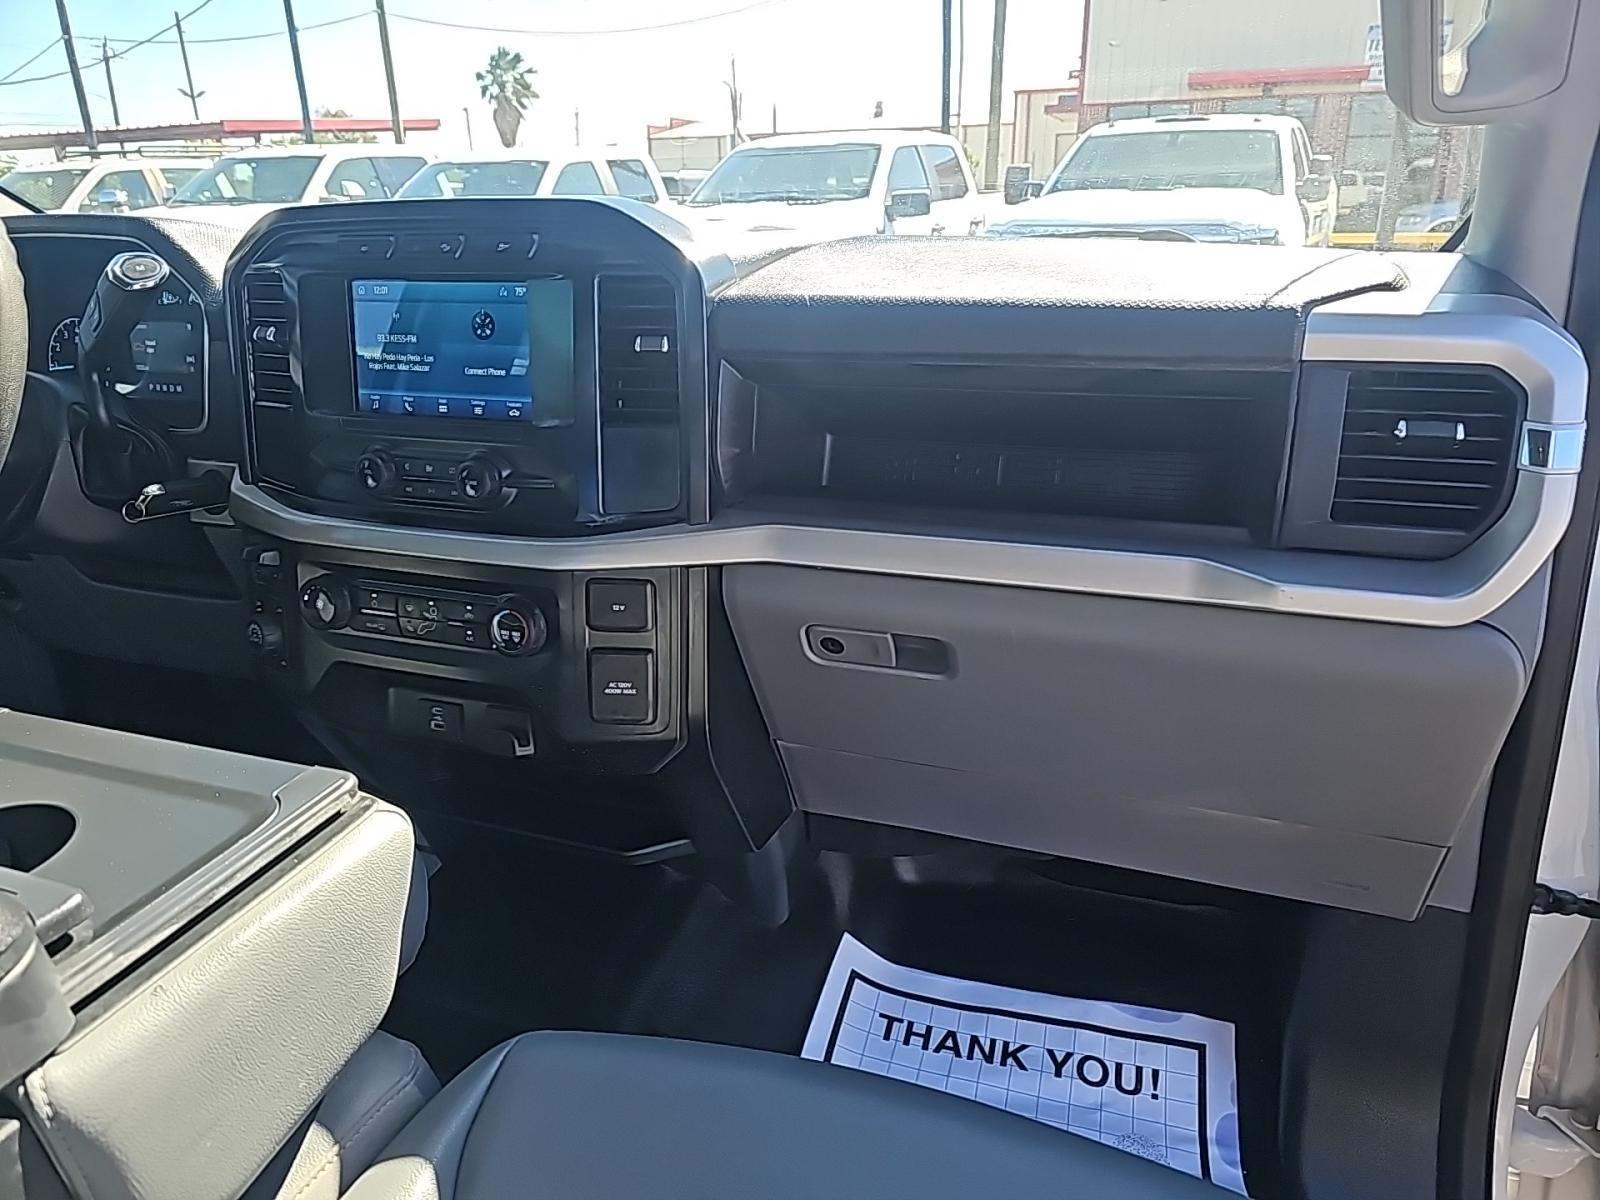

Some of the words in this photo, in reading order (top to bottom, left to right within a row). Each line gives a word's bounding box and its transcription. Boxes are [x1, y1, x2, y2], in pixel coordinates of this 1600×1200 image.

[376, 334, 390, 343] 93.3
[390, 334, 418, 344] KESS-FM
[464, 367, 487, 376] Connect
[487, 367, 507, 377] Phone
[878, 1012, 1032, 1072] THANK
[1046, 1048, 1160, 1101] YOU!
